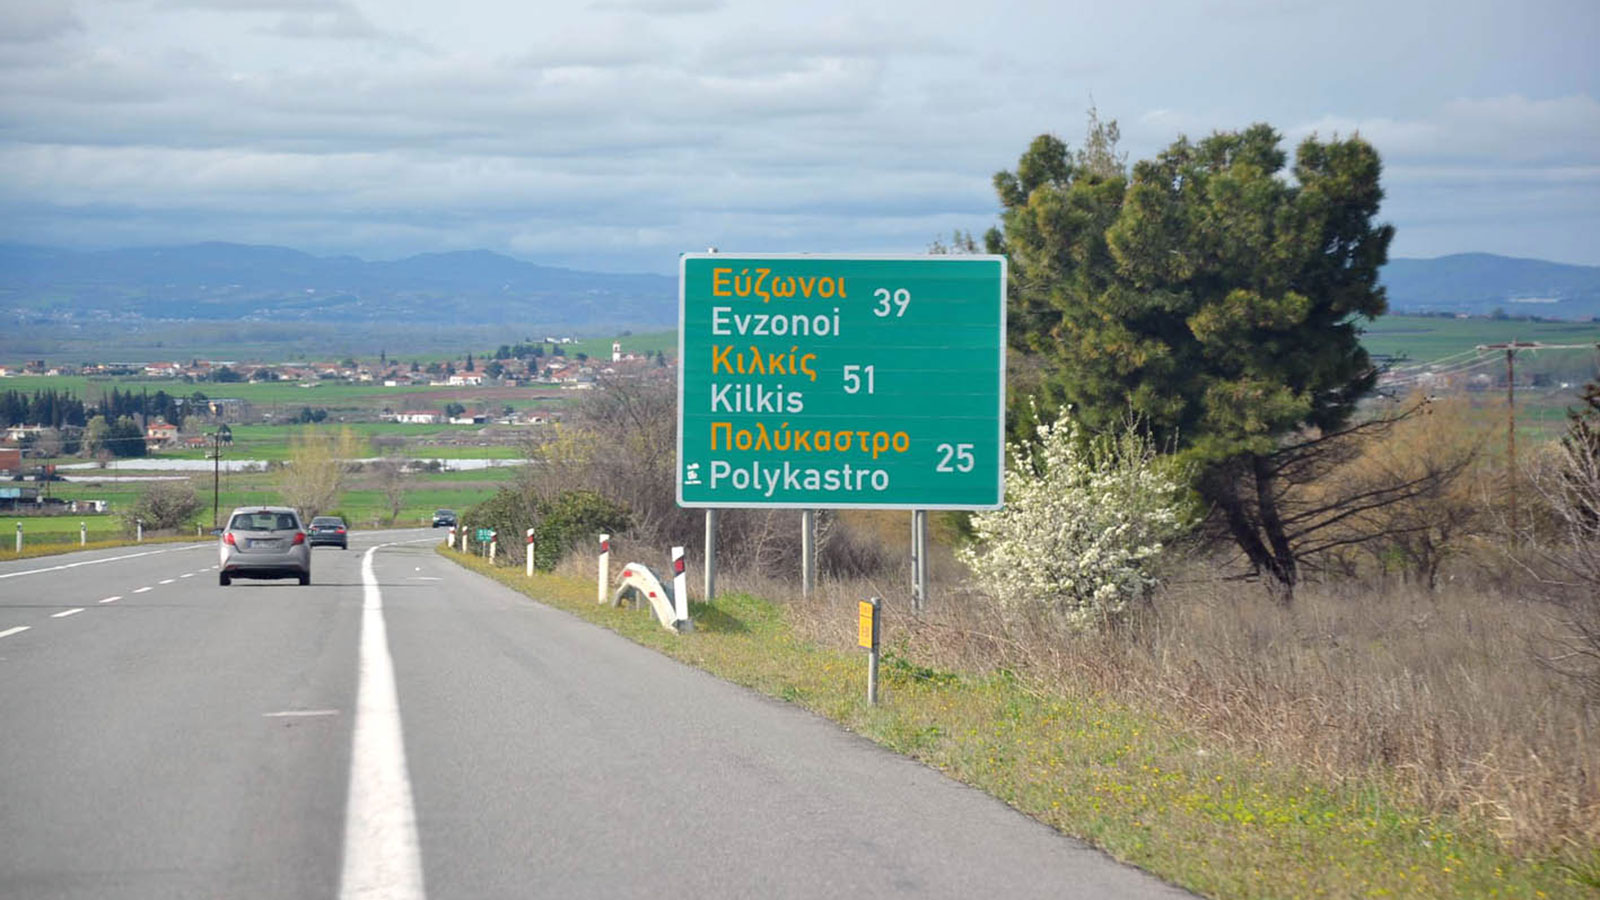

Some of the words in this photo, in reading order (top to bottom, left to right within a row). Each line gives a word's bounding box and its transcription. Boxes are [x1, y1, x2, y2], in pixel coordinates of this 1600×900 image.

[713, 267, 847, 303] Εύζωνοι
[873, 288, 911, 317] 39
[712, 306, 840, 336] Evzonoi
[712, 344, 817, 382] Κιλκίς
[843, 365, 874, 394] 51
[711, 383, 804, 413] Kilkis
[710, 421, 910, 460] Πολύκαστρο
[936, 443, 975, 473] 25
[710, 460, 889, 497] Polykastro
